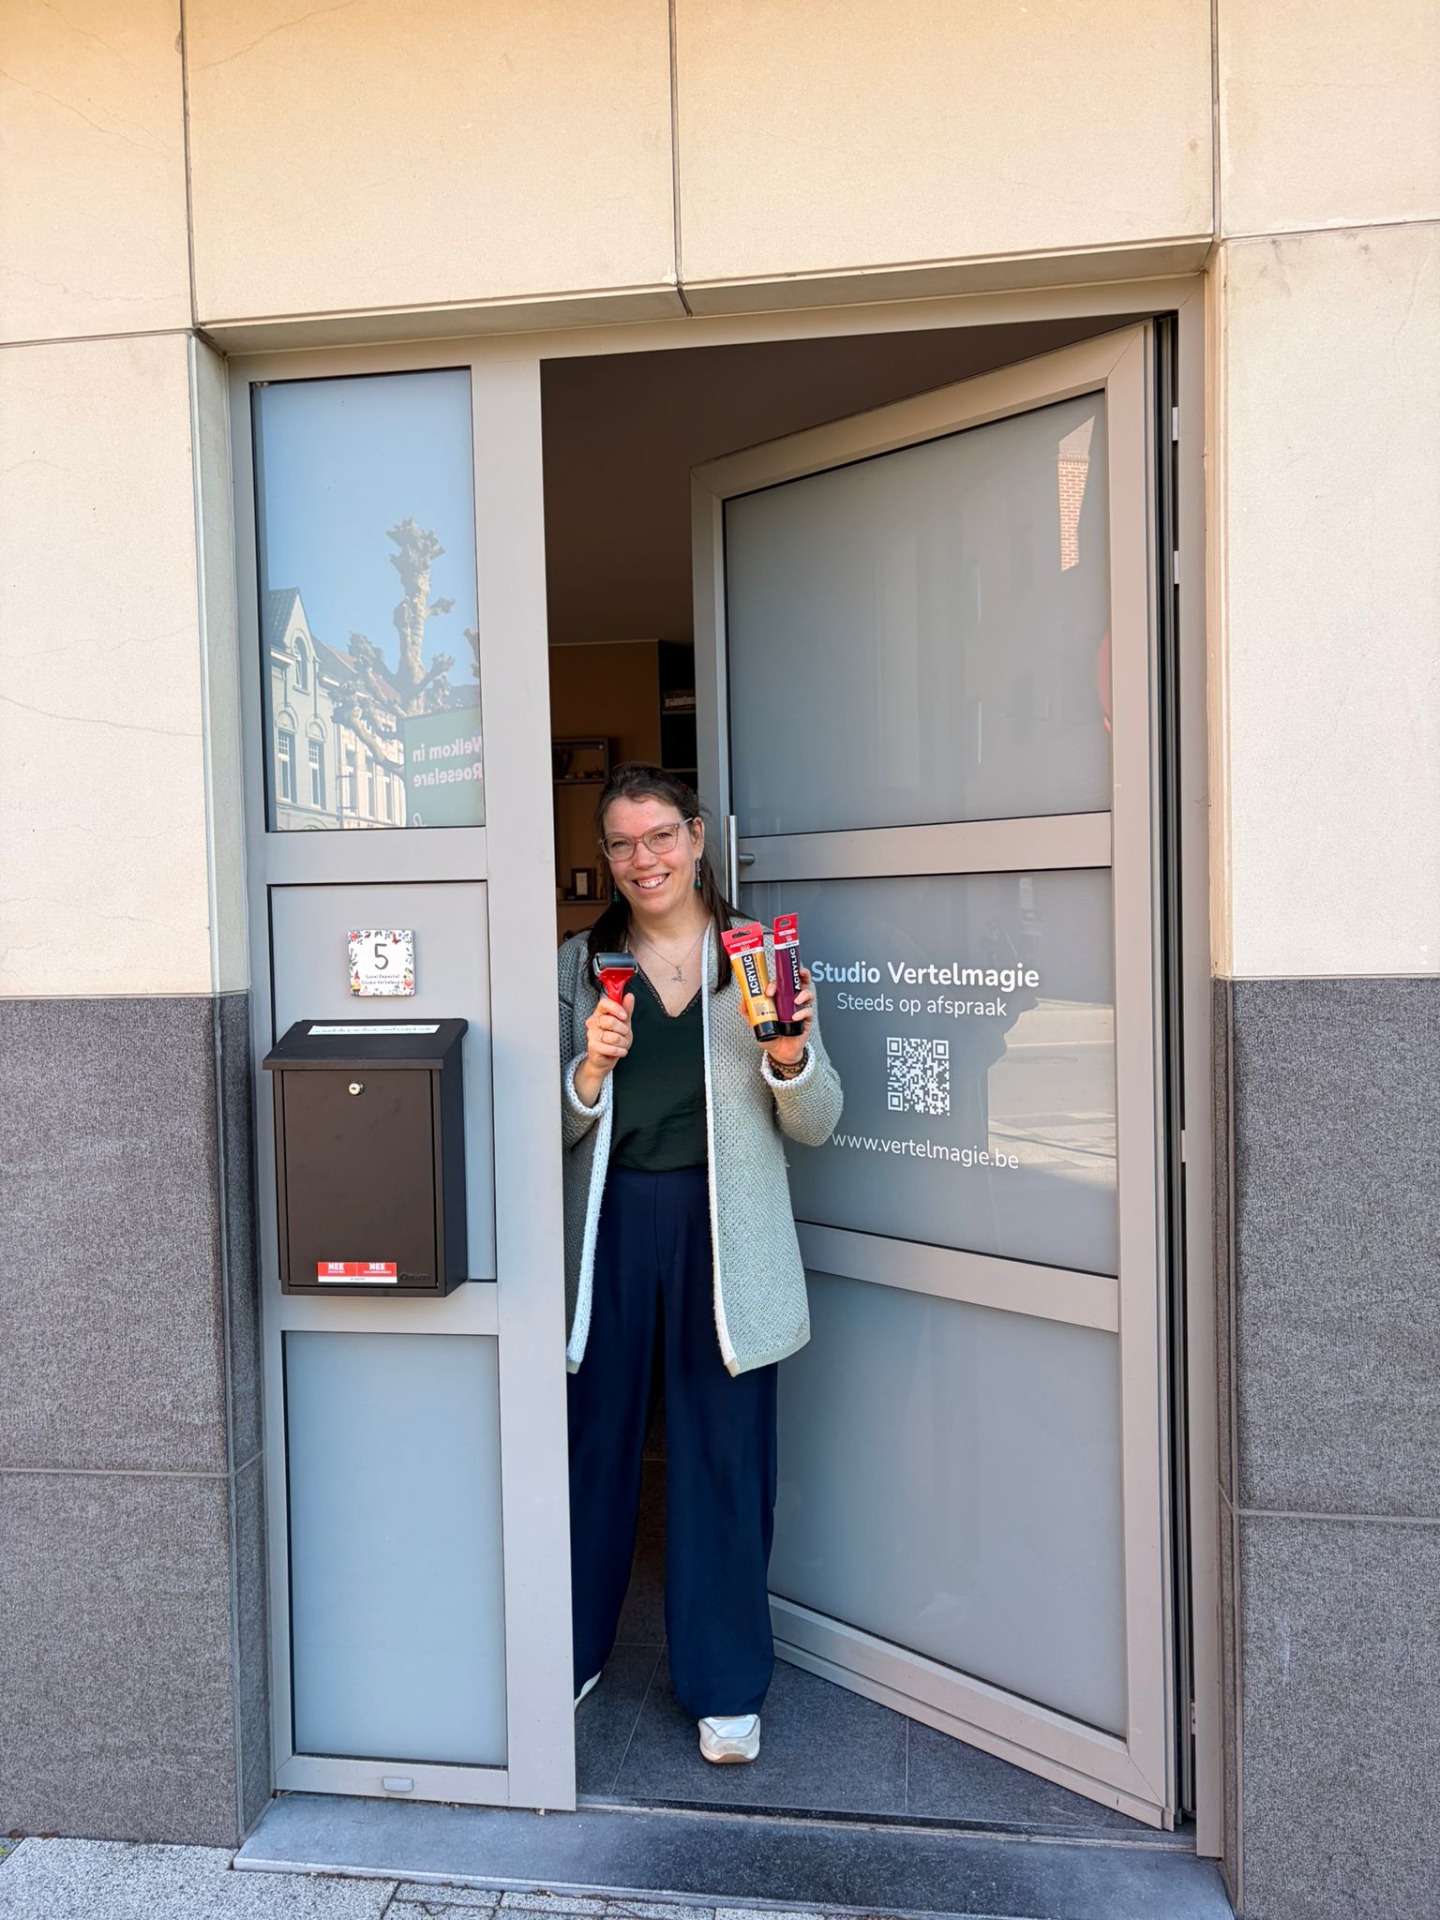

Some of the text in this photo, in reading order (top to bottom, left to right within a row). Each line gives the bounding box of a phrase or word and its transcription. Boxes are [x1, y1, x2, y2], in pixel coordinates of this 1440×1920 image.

[374, 943, 389, 970] 5
[789, 948, 801, 990] ACRYLIC
[743, 955, 760, 994] ACRYLIC
[810, 960, 1040, 993] Studio Vertelmagie
[836, 993, 1008, 1018] Steeds op afspraak
[831, 1133, 1020, 1169] www.vertelmagie.be
